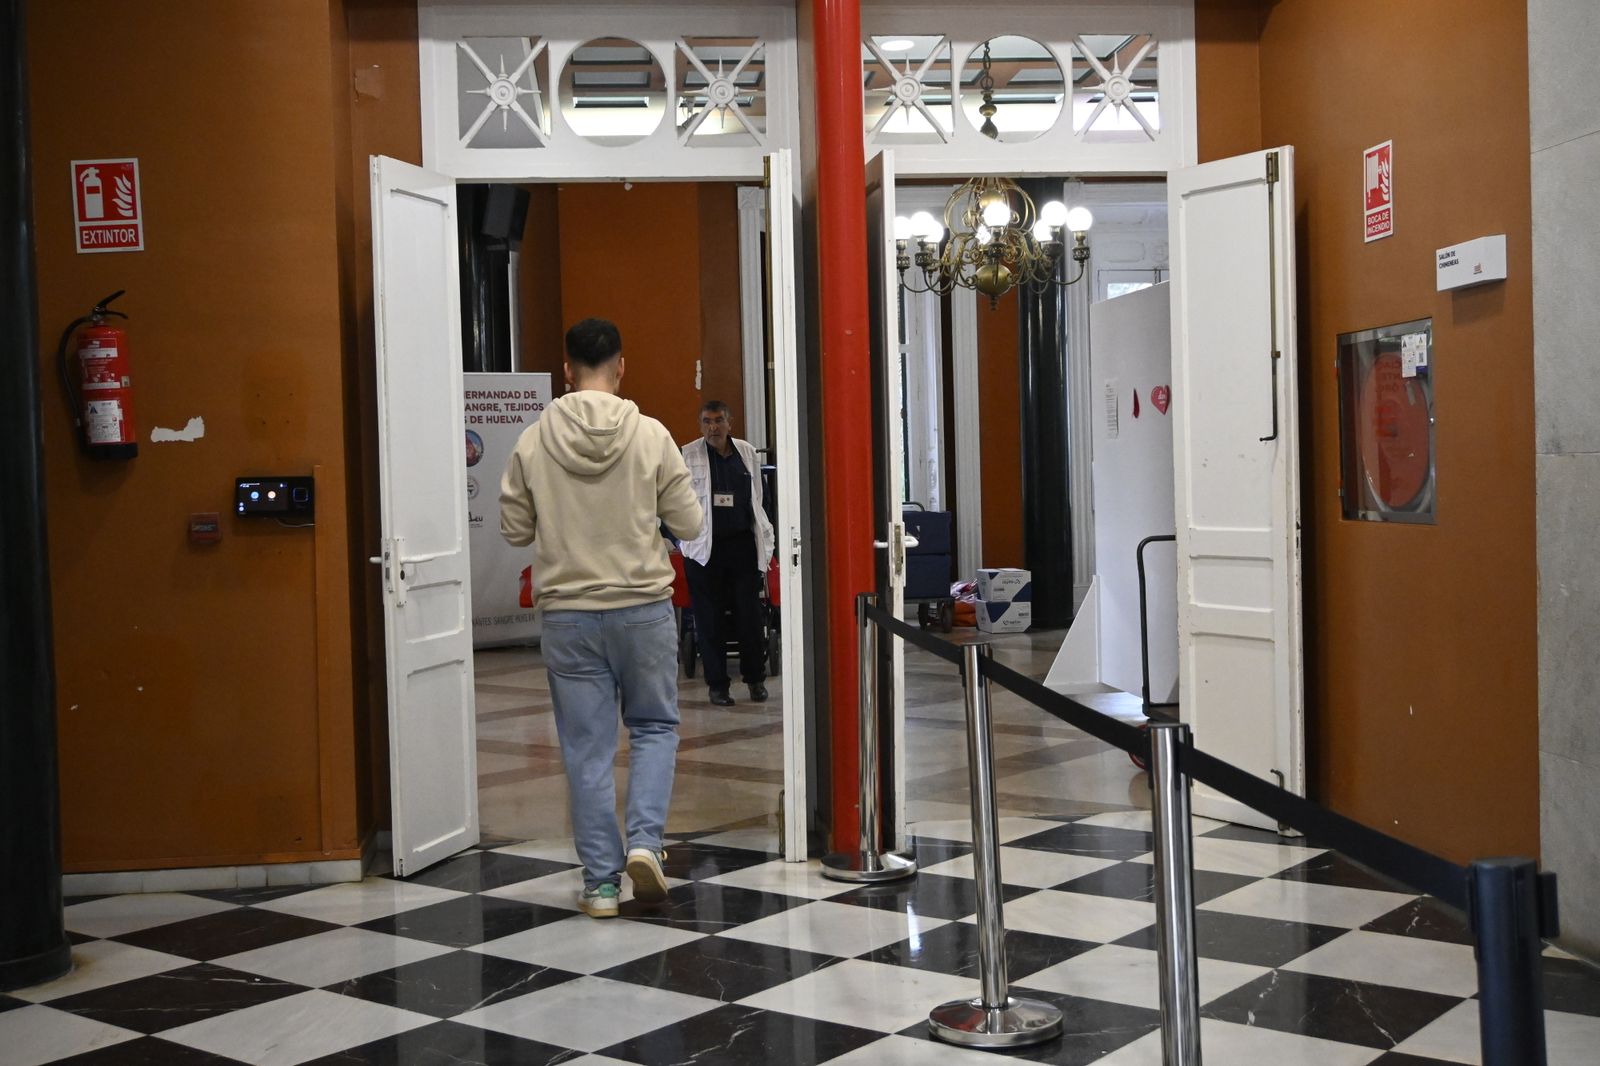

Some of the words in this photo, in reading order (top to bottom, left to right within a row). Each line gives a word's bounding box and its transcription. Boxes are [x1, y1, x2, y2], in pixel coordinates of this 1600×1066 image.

[1368, 214, 1381, 225] BOCA
[1382, 211, 1389, 220] DE
[1367, 220, 1390, 235] INCENDIO
[82, 228, 136, 245] EXTINTOR
[464, 391, 521, 399] ERMANDAD
[524, 391, 537, 399] DE
[464, 403, 502, 413] ANGRE,
[504, 403, 544, 411] TEJIDOS
[470, 415, 484, 424] DE
[486, 415, 524, 424] HUELVA
